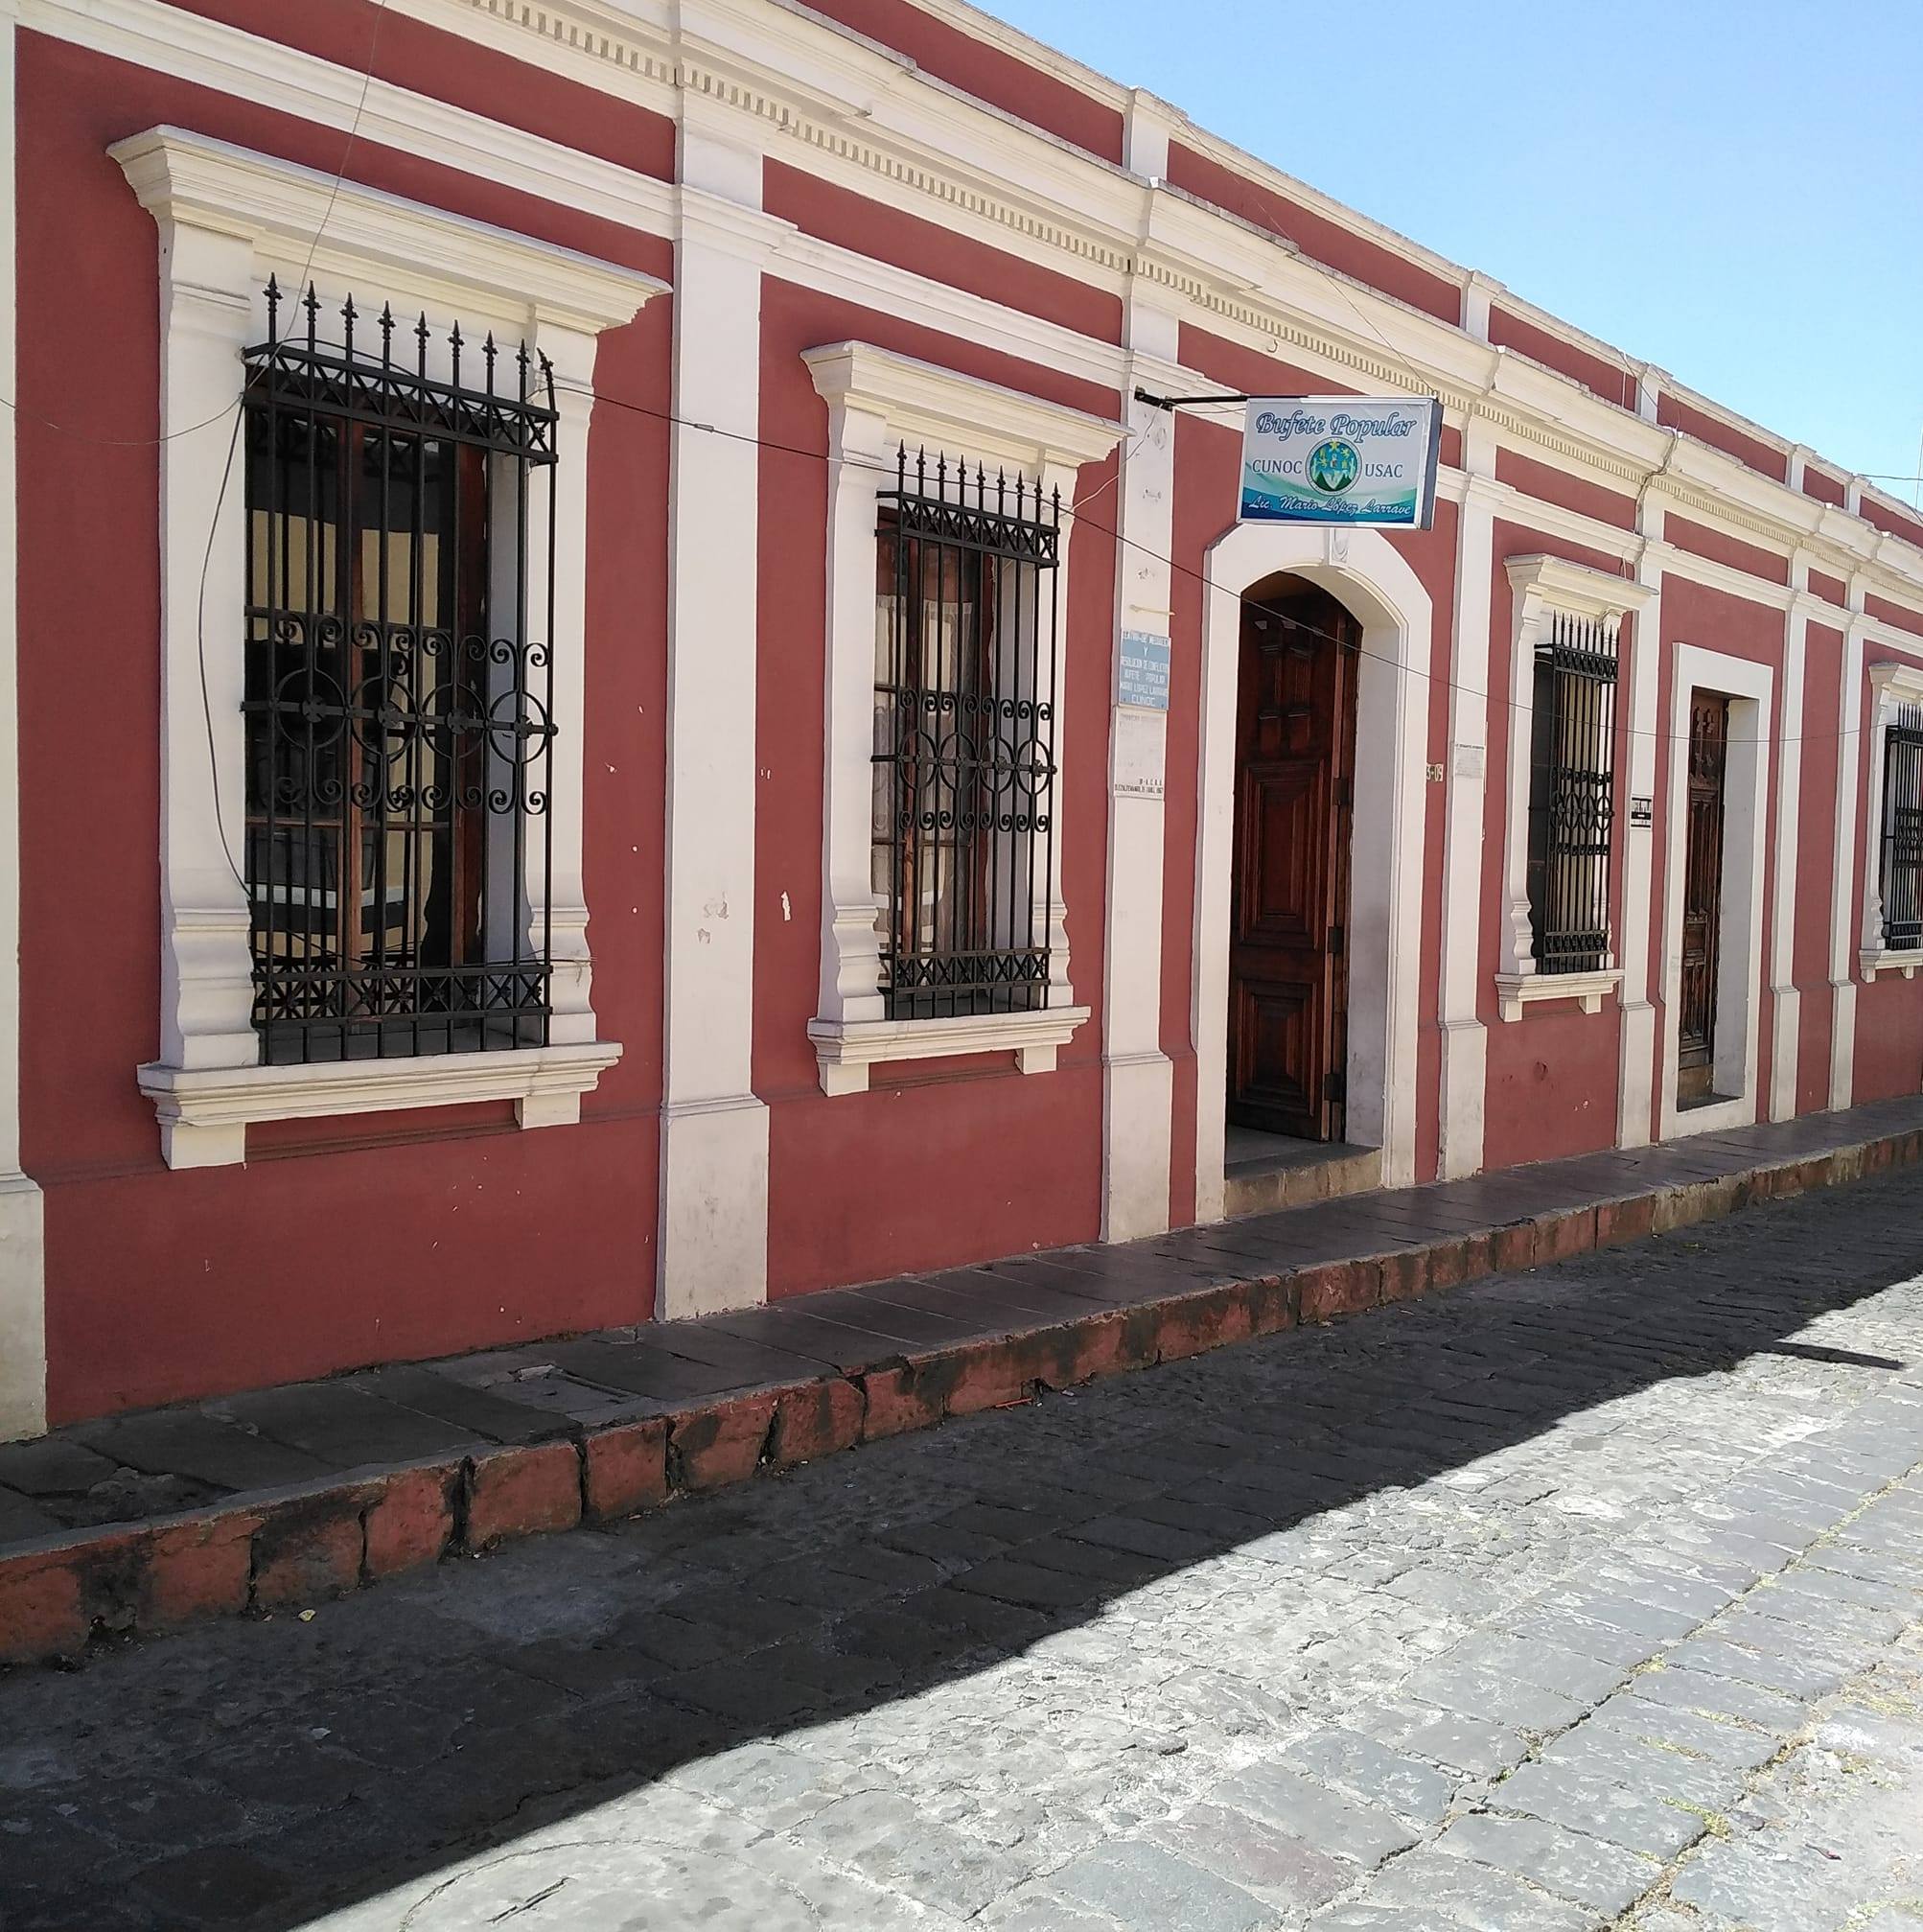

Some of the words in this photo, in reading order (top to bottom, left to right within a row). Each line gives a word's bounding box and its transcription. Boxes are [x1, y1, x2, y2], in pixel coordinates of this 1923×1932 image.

[1256, 409, 1326, 441] Bufete
[1331, 412, 1417, 443] Popular
[1252, 459, 1303, 475] CUNOC
[1365, 463, 1403, 478] USAC
[1280, 495, 1319, 511] Mario
[1359, 499, 1412, 515] Larrave
